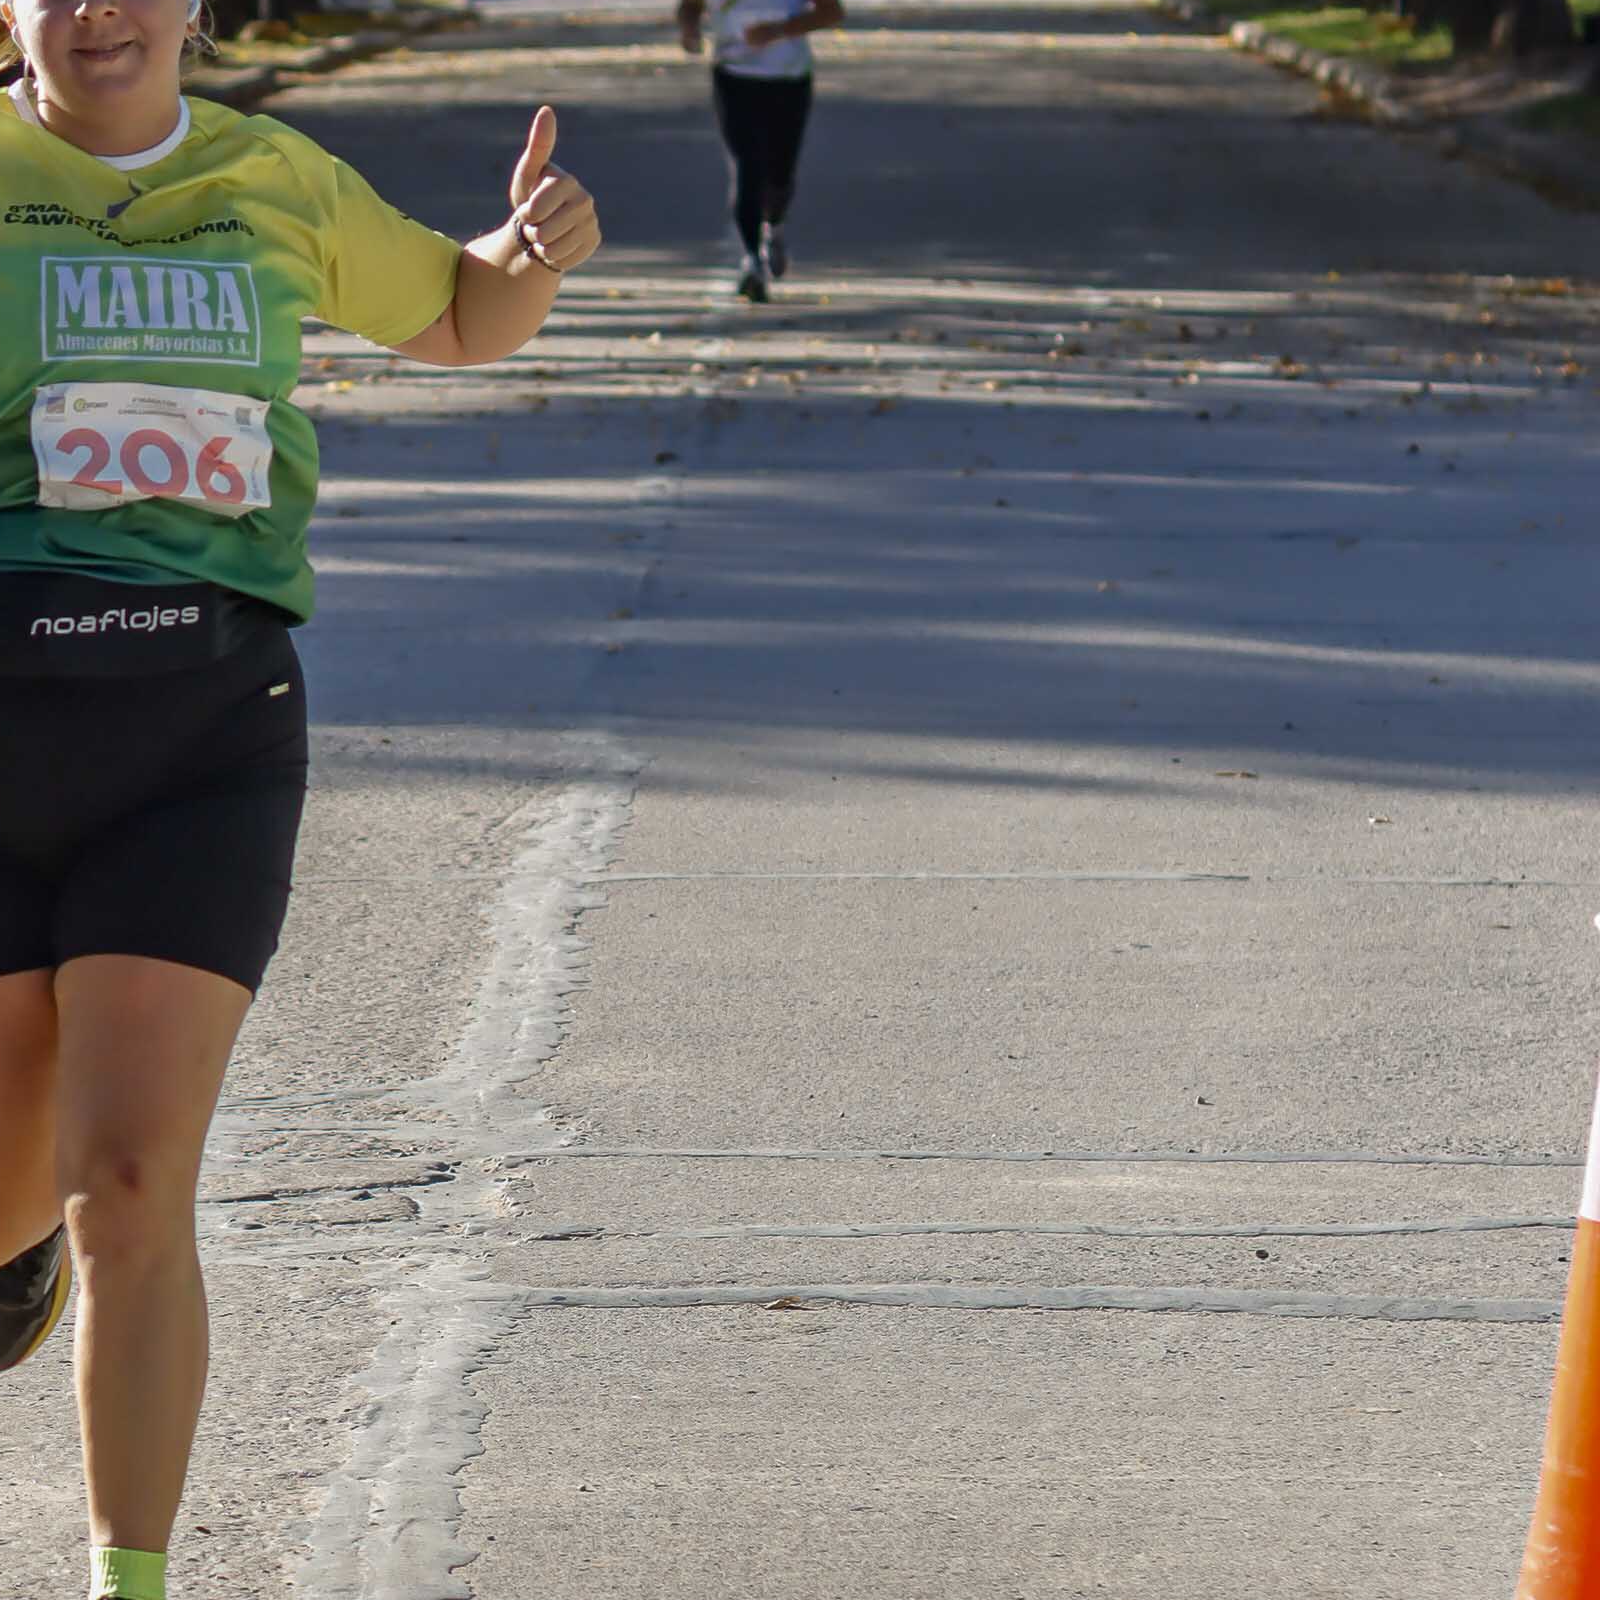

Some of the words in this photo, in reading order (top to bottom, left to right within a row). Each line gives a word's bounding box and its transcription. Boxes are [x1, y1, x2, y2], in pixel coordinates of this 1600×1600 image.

[55, 265, 250, 333] MAIRA
[56, 333, 138, 351] Almacenes
[143, 334, 224, 354] Mayoristas
[55, 427, 247, 505] 206
[29, 605, 201, 636] noaflojes
